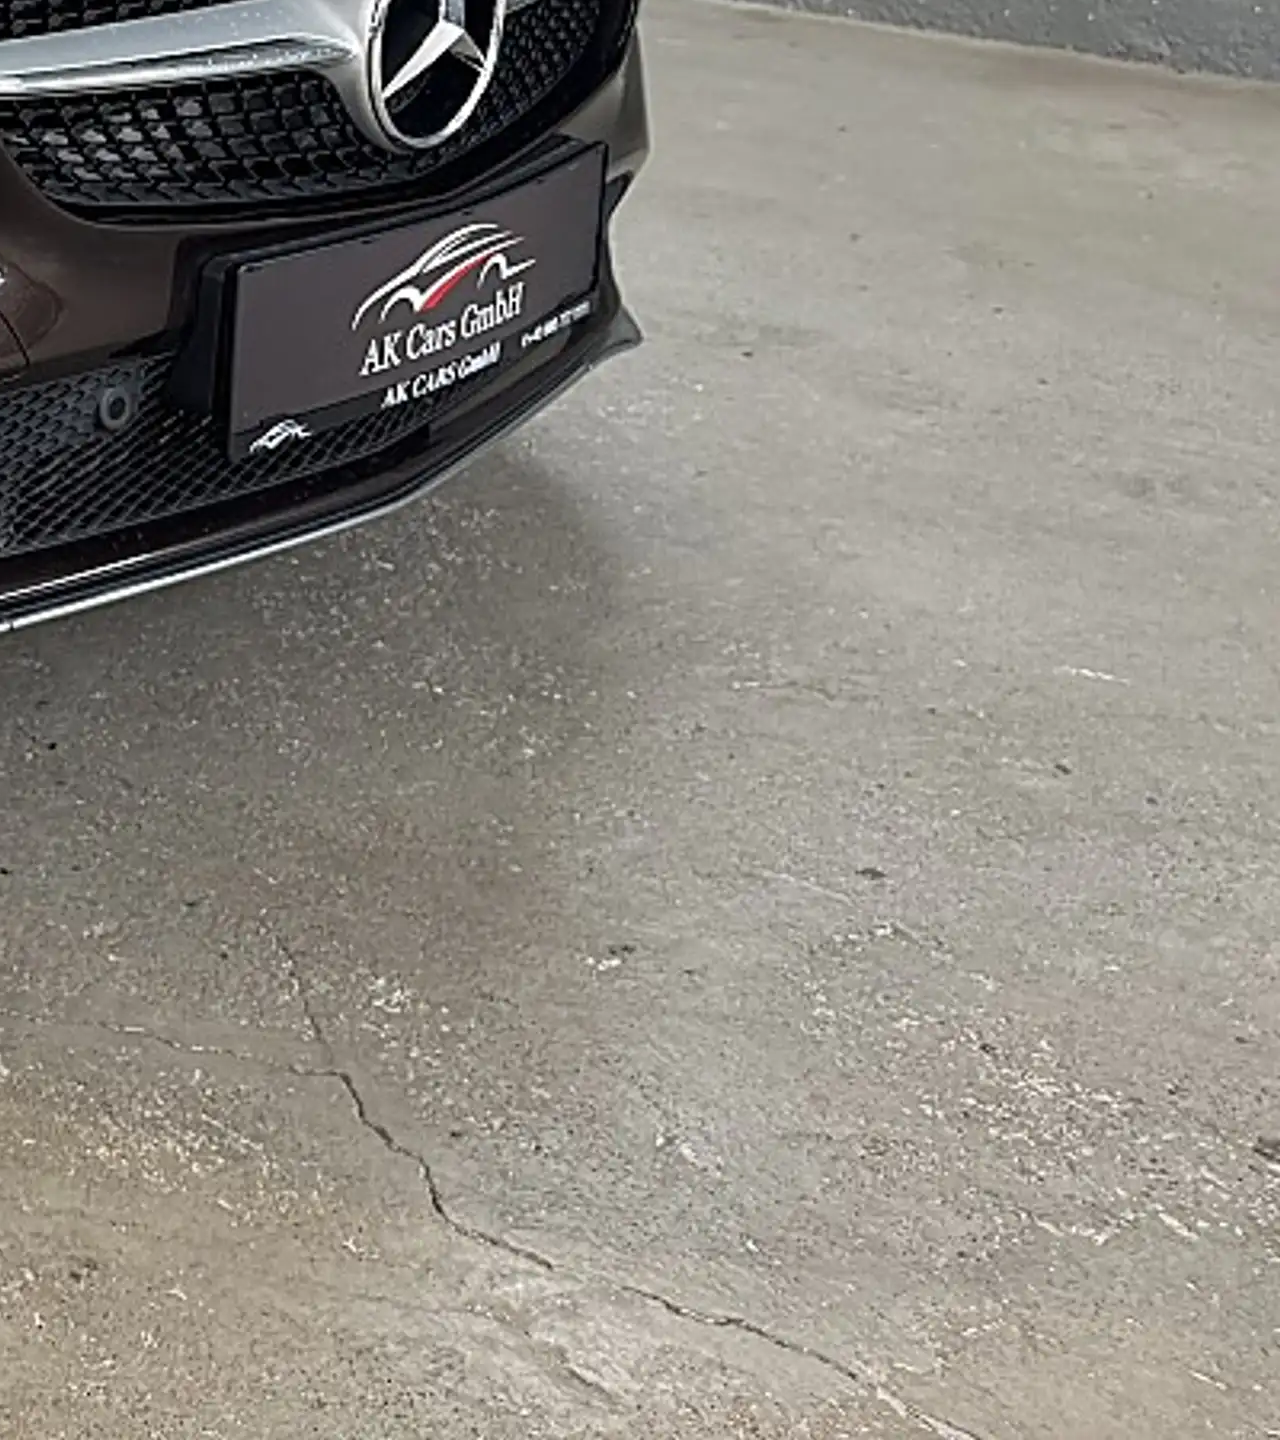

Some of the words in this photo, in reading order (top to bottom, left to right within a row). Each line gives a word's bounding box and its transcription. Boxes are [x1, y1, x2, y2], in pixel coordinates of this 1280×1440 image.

[359, 330, 403, 376] AK
[406, 321, 457, 360] Cars
[461, 281, 526, 340] GmbH
